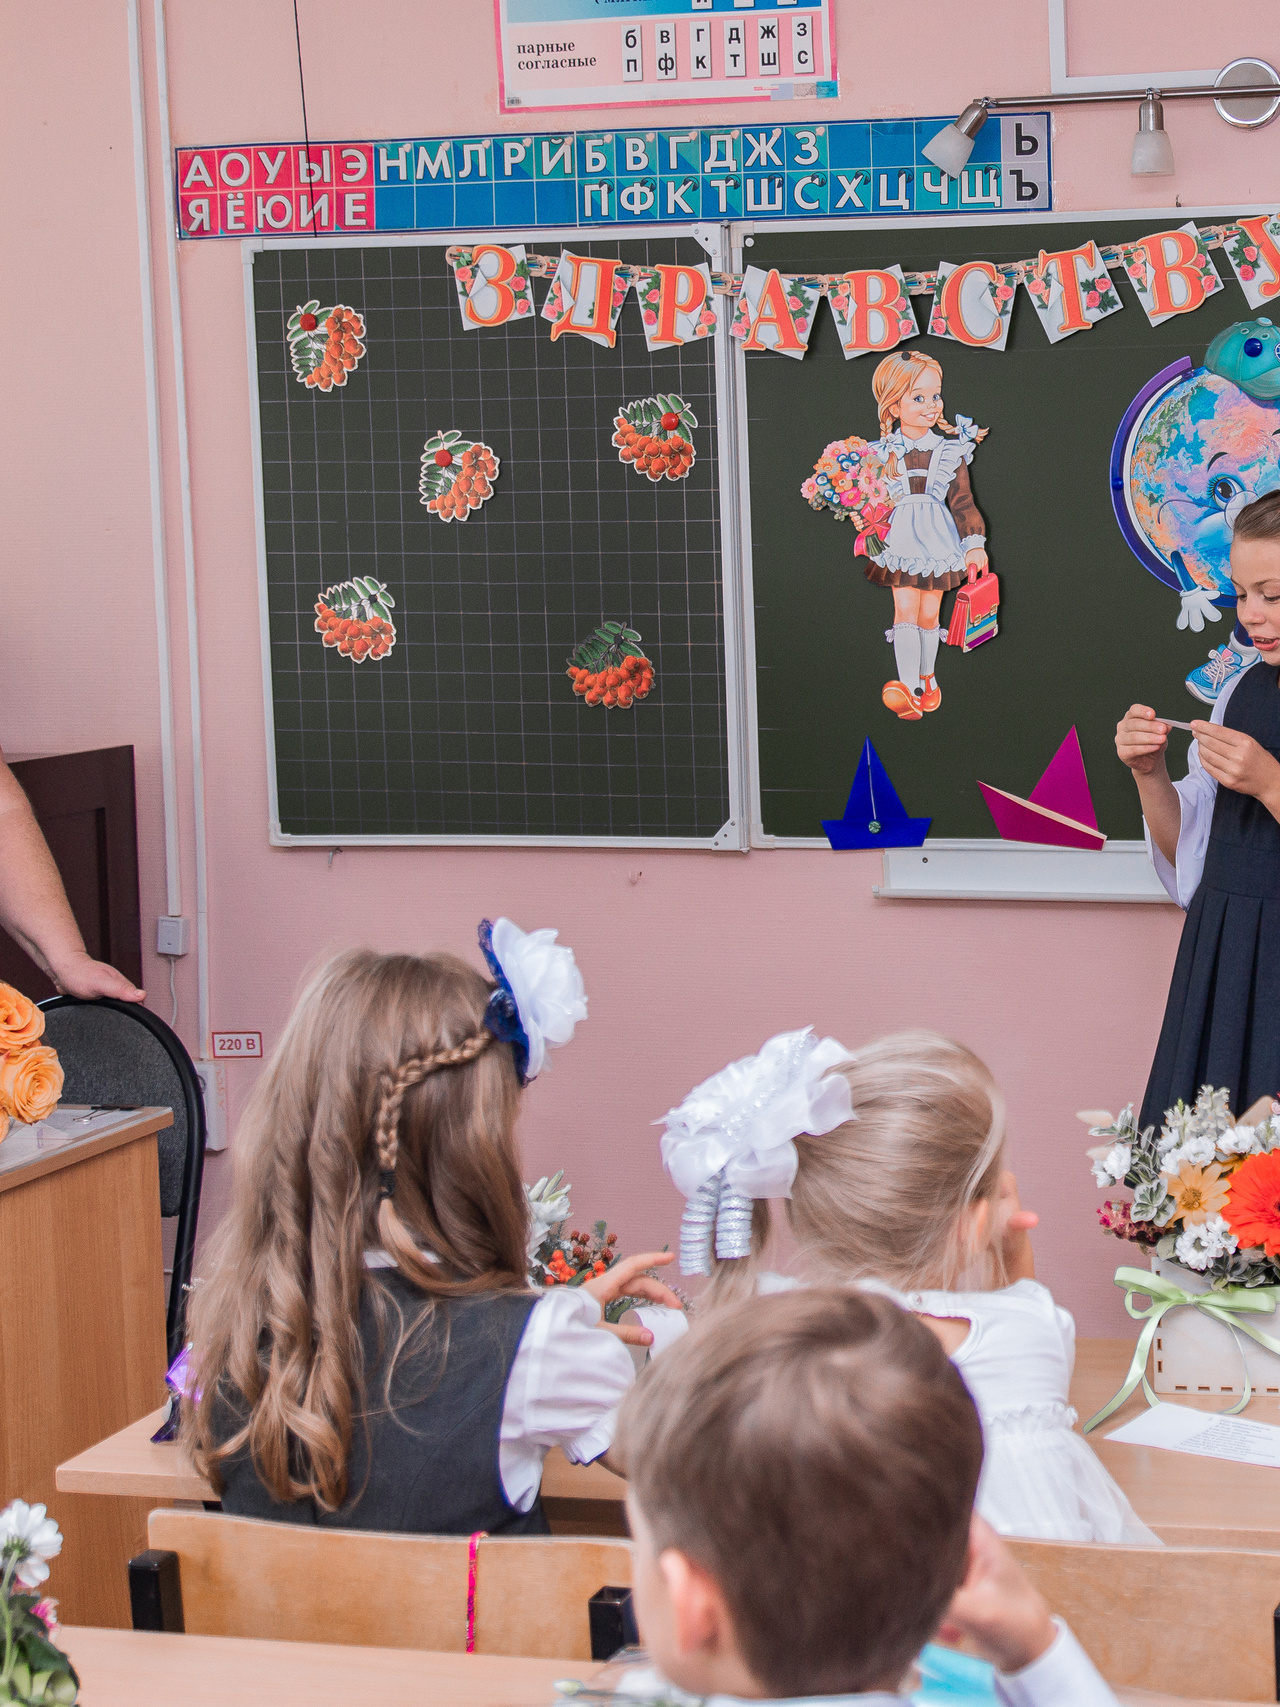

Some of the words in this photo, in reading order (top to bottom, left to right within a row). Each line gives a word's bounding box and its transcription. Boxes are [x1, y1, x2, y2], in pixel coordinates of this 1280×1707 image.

[516, 42, 575, 56] парные
[518, 57, 597, 71] согласные
[218, 1038, 242, 1050] 220
[246, 1038, 256, 1050] В
